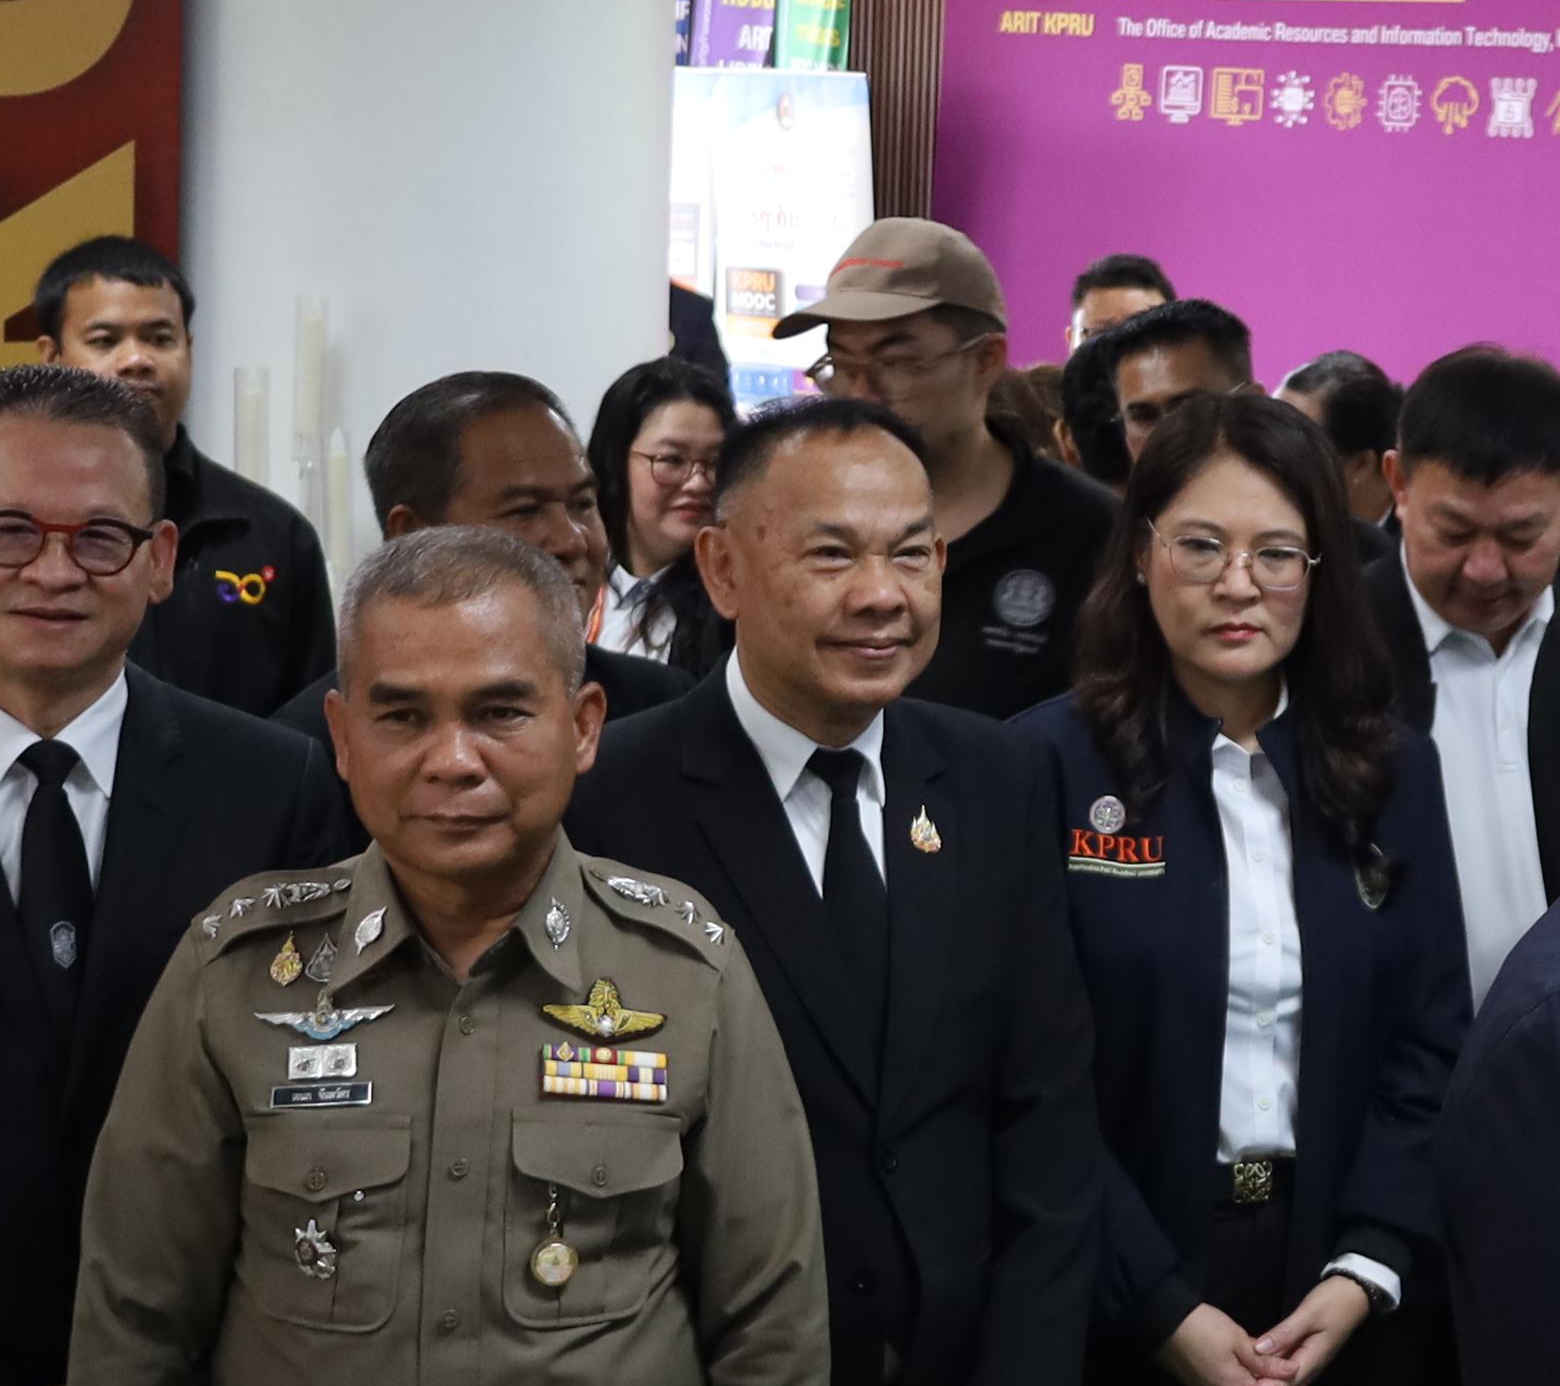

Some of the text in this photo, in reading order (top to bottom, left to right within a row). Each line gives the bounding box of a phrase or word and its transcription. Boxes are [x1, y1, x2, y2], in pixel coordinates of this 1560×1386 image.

[1000, 10, 1095, 37] ARIT KPRU
[1118, 17, 1144, 36] The
[1146, 18, 1186, 38] Office
[1188, 20, 1203, 38] of
[1205, 21, 1272, 42] Academic
[1274, 22, 1349, 44] Resources
[1351, 25, 1378, 44] and
[1380, 25, 1462, 46] Information
[1464, 26, 1554, 52] Technology,
[731, 269, 775, 291] KPRU
[1069, 829, 1165, 863] KPRU
